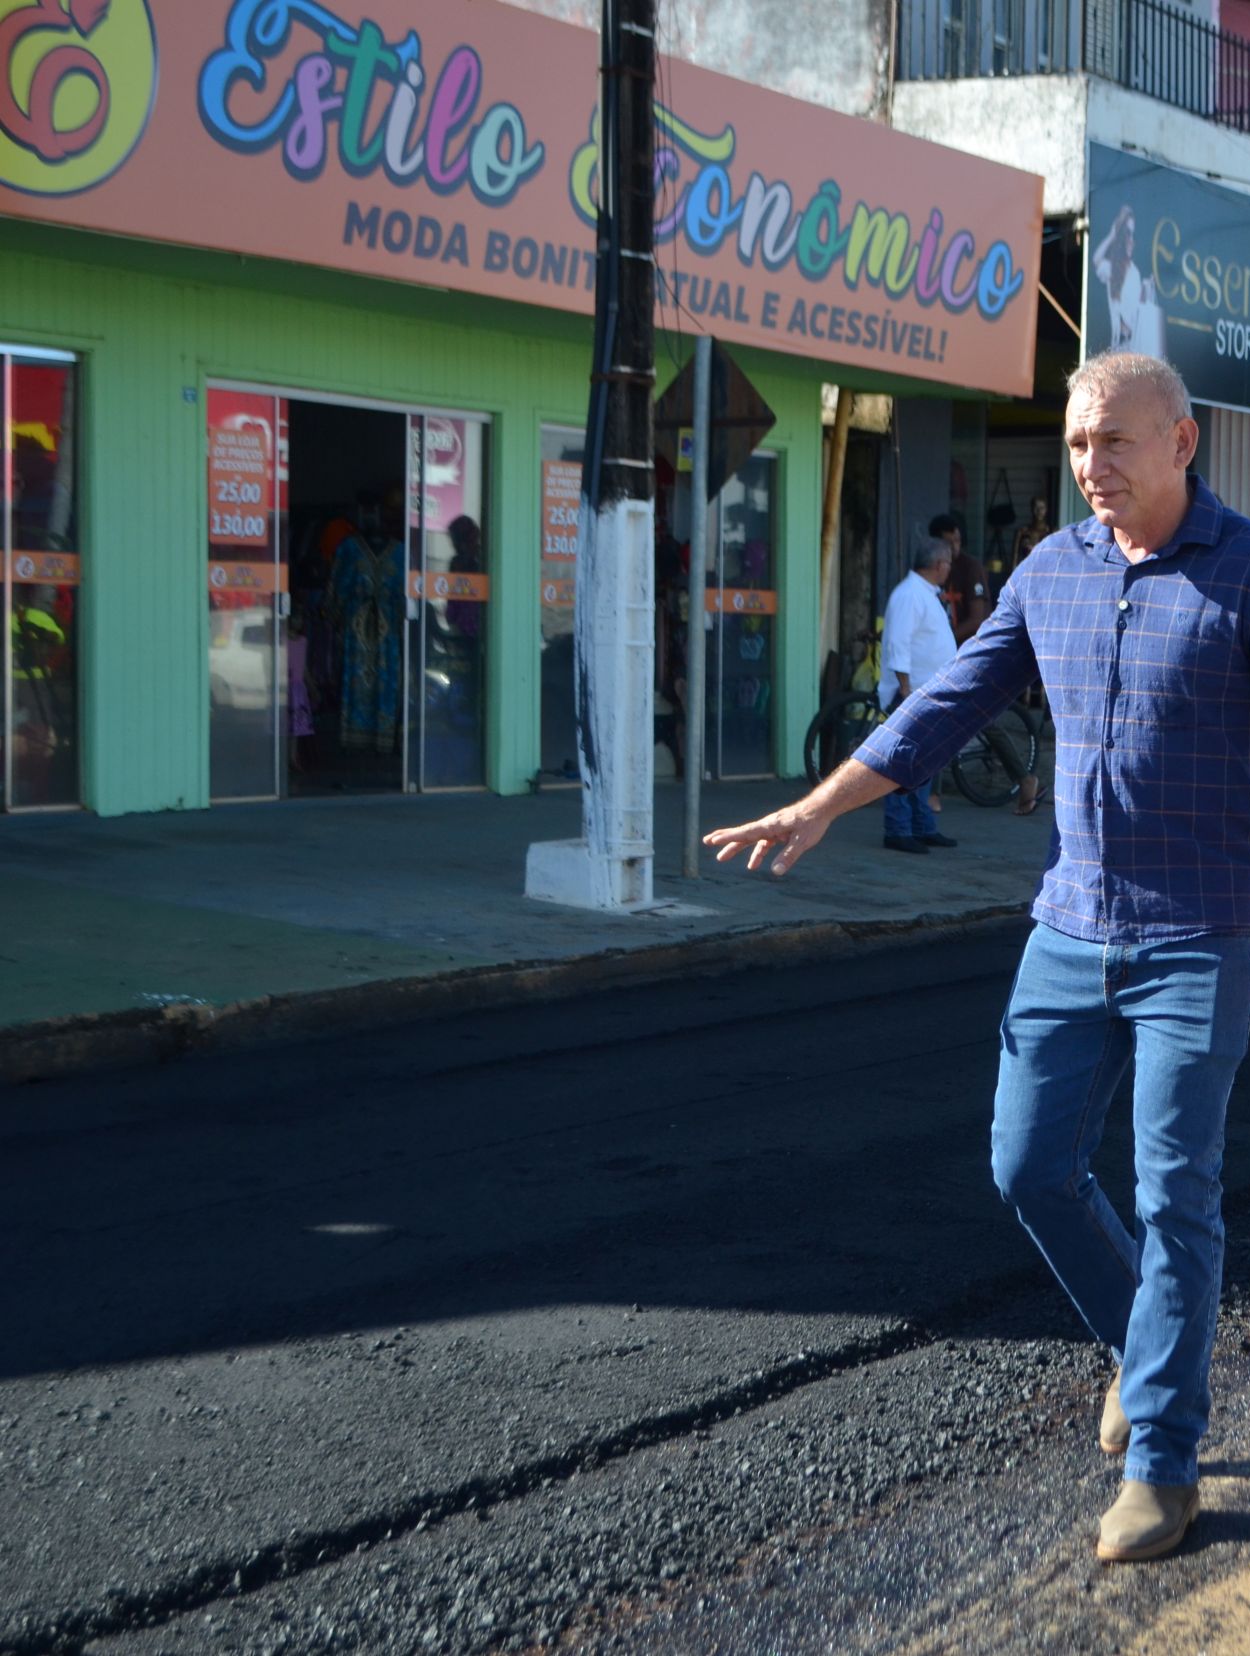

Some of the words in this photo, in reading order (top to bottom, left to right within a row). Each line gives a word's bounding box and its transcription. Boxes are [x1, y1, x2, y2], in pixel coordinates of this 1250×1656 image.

[199, 0, 546, 207] Estilo
[342, 201, 471, 267] MODA
[484, 231, 598, 292] BONIT
[760, 291, 780, 329] E
[787, 299, 949, 364] ACESSÍVEL!
